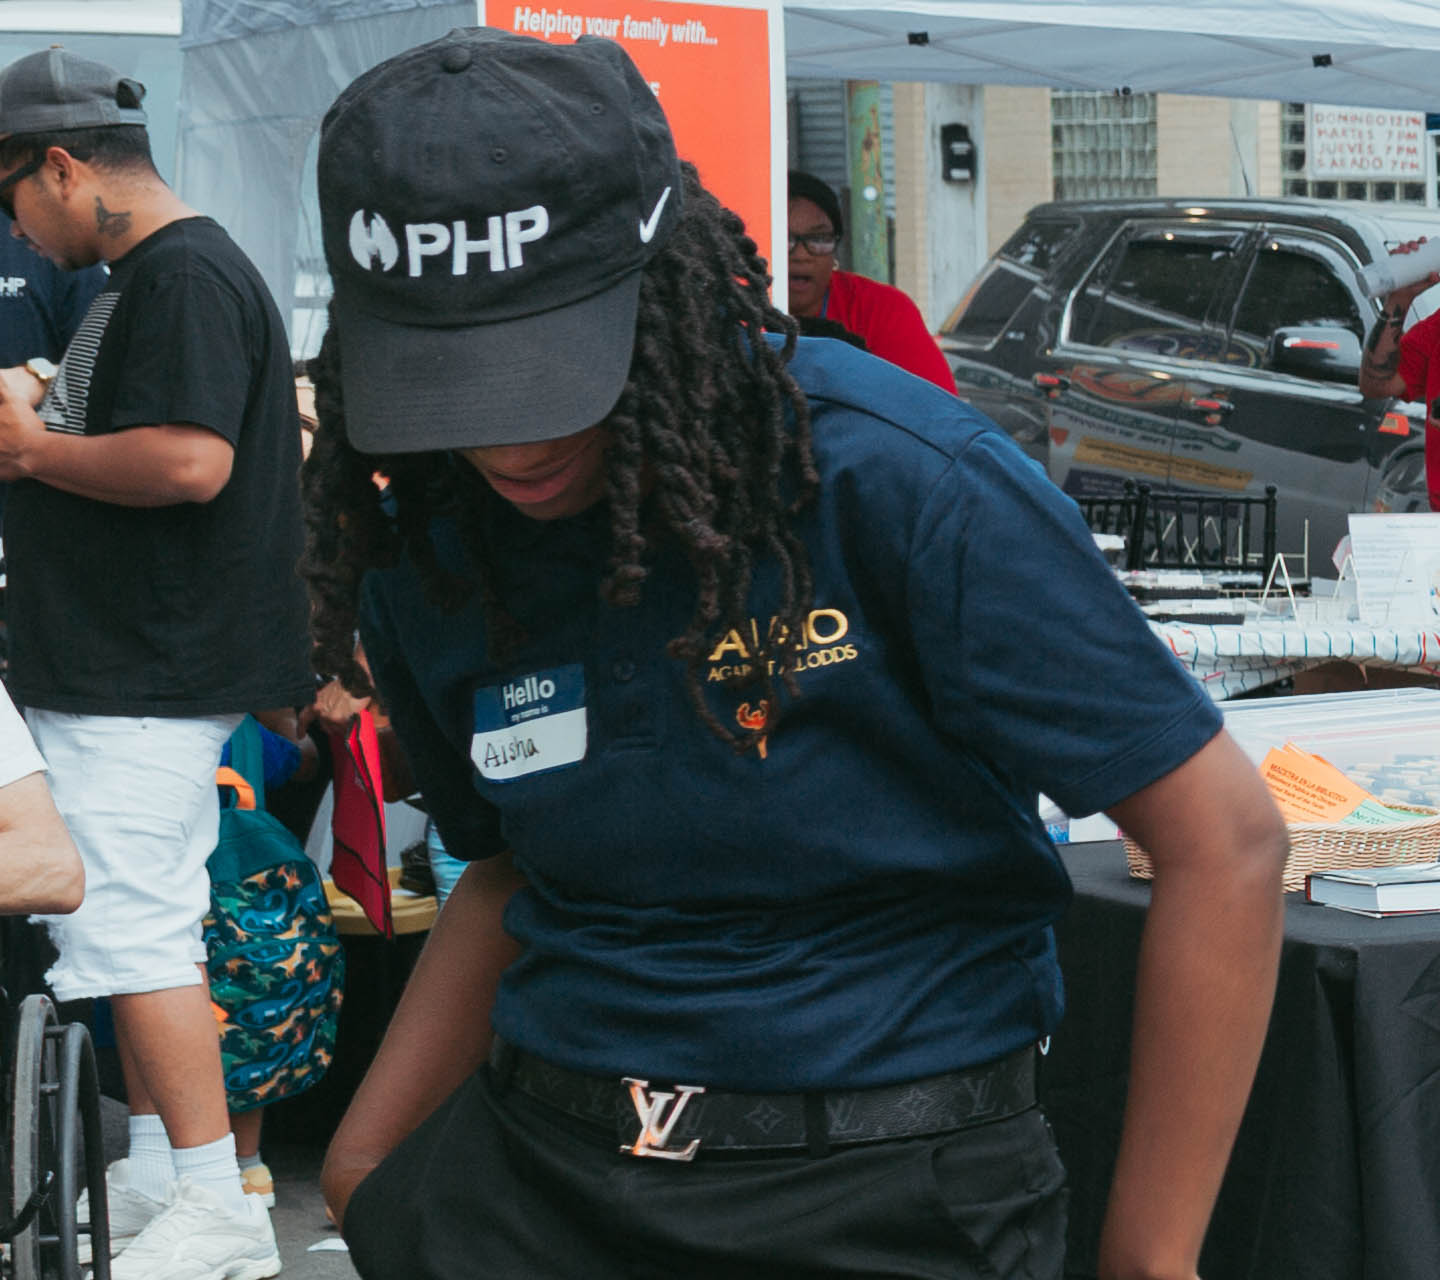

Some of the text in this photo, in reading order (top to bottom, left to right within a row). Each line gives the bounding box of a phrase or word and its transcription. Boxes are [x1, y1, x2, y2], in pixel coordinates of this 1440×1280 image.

[514, 6, 582, 38] Helping
[586, 16, 620, 38] your
[622, 15, 668, 47] family
[1317, 127, 1374, 141] MARTES
[405, 204, 549, 278] PHP
[0, 276, 26, 294] HP
[806, 643, 859, 669] ODDS
[503, 676, 556, 711] Hello
[484, 736, 540, 768] Aisha
